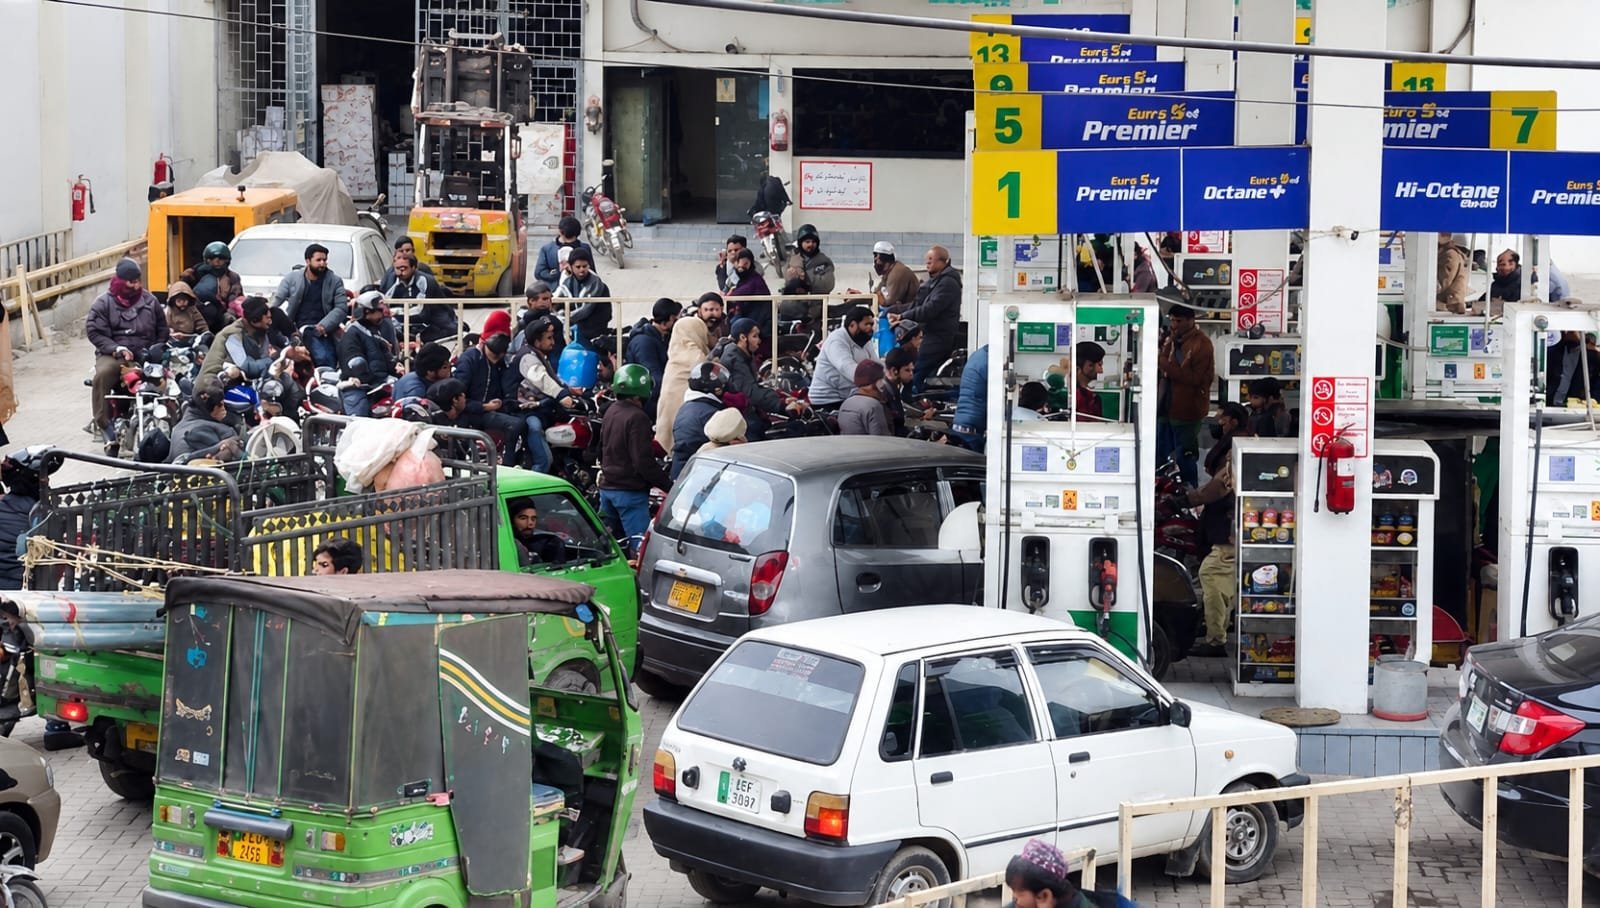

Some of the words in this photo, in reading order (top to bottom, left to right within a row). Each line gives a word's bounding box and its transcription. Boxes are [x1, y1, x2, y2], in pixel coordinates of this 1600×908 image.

[995, 107, 1022, 144] 5
[1082, 120, 1197, 141] Premier
[1383, 119, 1448, 138] mier
[1512, 107, 1539, 144] 7
[998, 171, 1020, 218] 1
[1076, 186, 1157, 201] Premier
[1395, 181, 1500, 199] Hi-Octane
[1531, 189, 1600, 205] Premie
